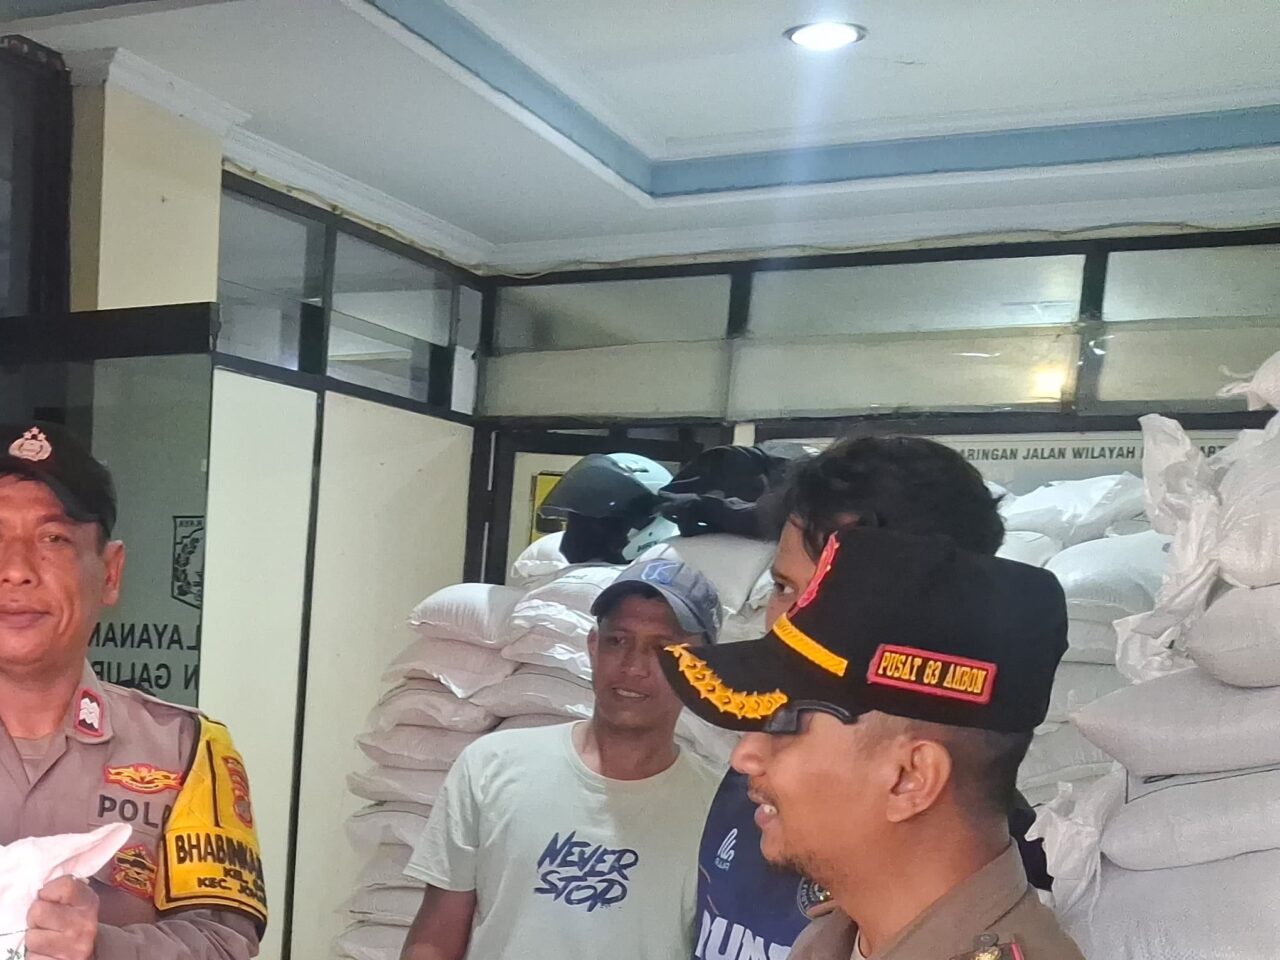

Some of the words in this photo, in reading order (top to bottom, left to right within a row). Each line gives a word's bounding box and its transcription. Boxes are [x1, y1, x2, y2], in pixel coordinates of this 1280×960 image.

[1022, 447, 1066, 460] JALAN
[1072, 446, 1135, 459] WILAYAH
[878, 651, 921, 681] PUSAT
[537, 830, 639, 881] NEVER
[534, 869, 628, 913] STOP
